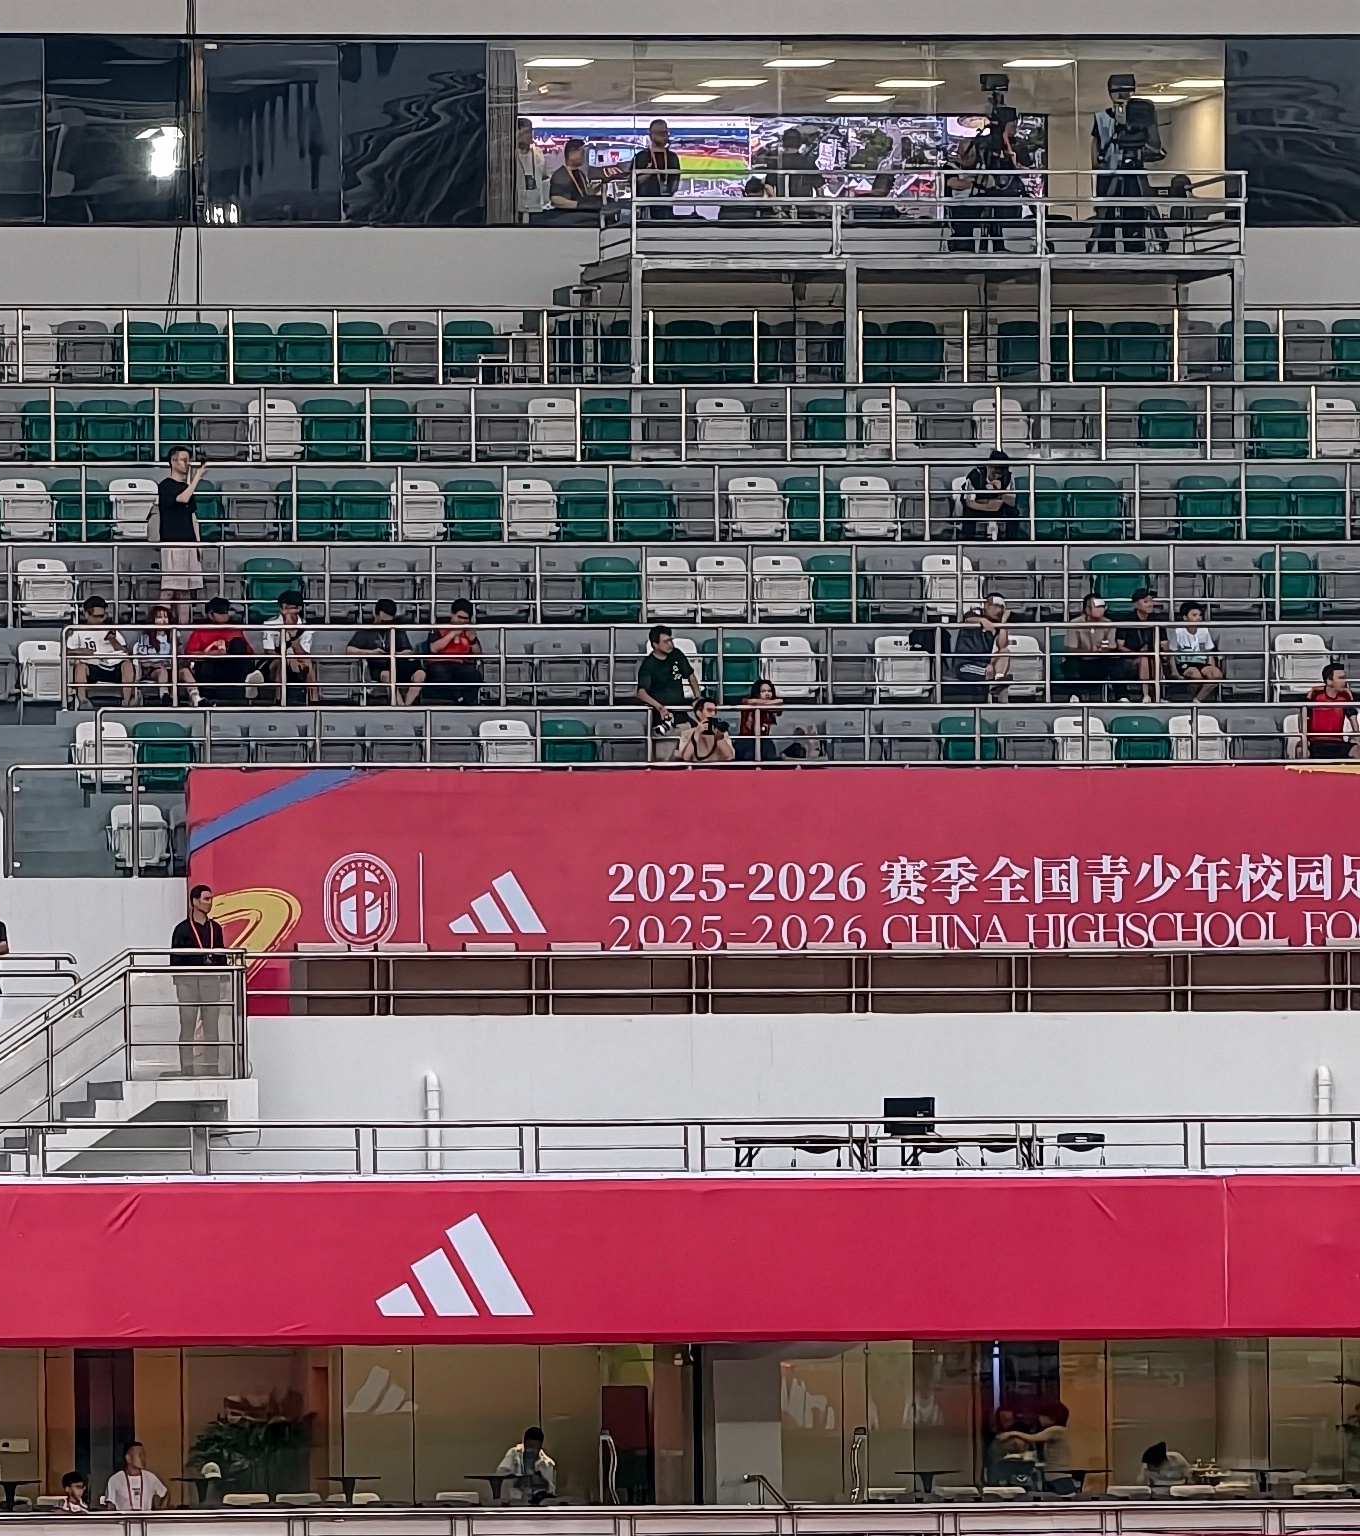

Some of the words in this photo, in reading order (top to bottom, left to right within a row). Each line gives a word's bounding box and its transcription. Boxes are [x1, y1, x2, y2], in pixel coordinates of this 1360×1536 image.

[608, 862, 866, 902] 2025-2026
[609, 914, 867, 950] 2025-2026
[882, 912, 1008, 950] CHINA
[1025, 911, 1289, 949] HIGHSCHOOL
[1302, 910, 1360, 947] FO
